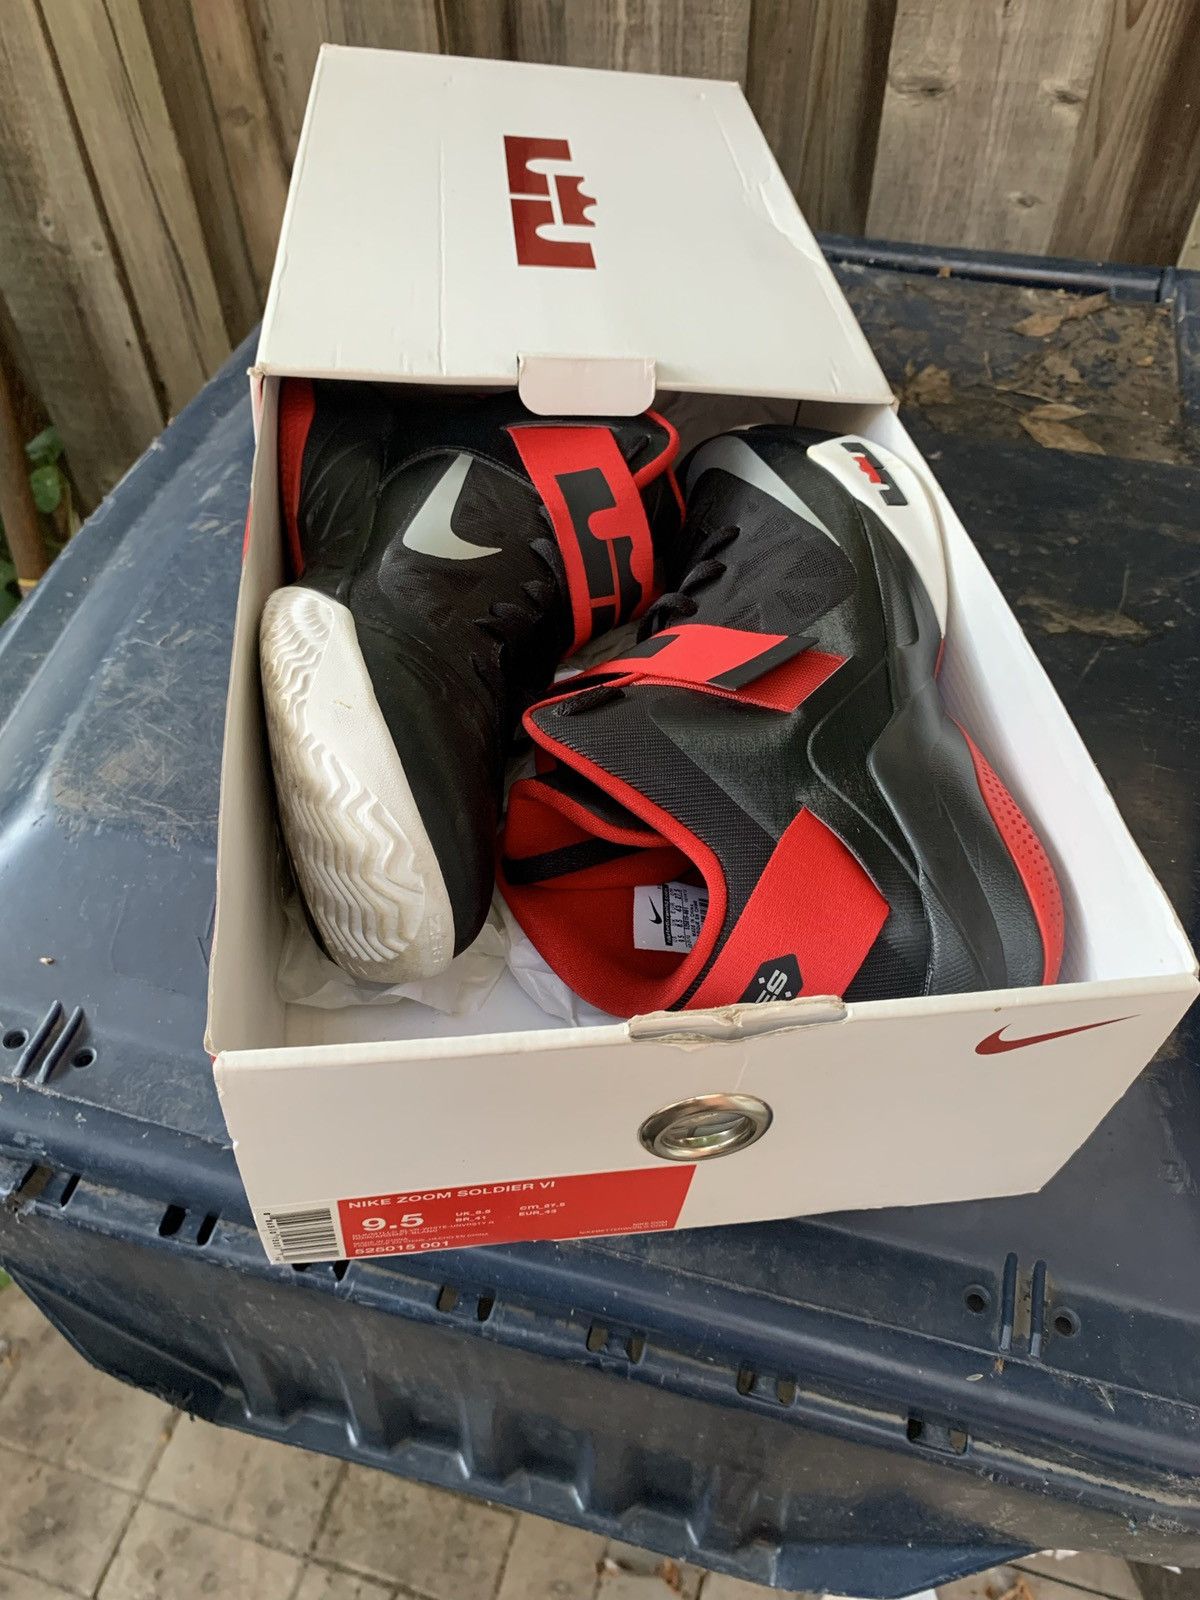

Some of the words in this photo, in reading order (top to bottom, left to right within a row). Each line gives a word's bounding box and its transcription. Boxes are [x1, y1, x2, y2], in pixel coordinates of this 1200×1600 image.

[349, 1198, 391, 1209] NIKE
[396, 1191, 452, 1204] ZOOM
[457, 1183, 534, 1197] SOLDIER
[539, 1181, 556, 1189] VI
[362, 1213, 424, 1231] 9.5
[355, 1243, 415, 1254] 525015
[421, 1240, 449, 1249] 001
